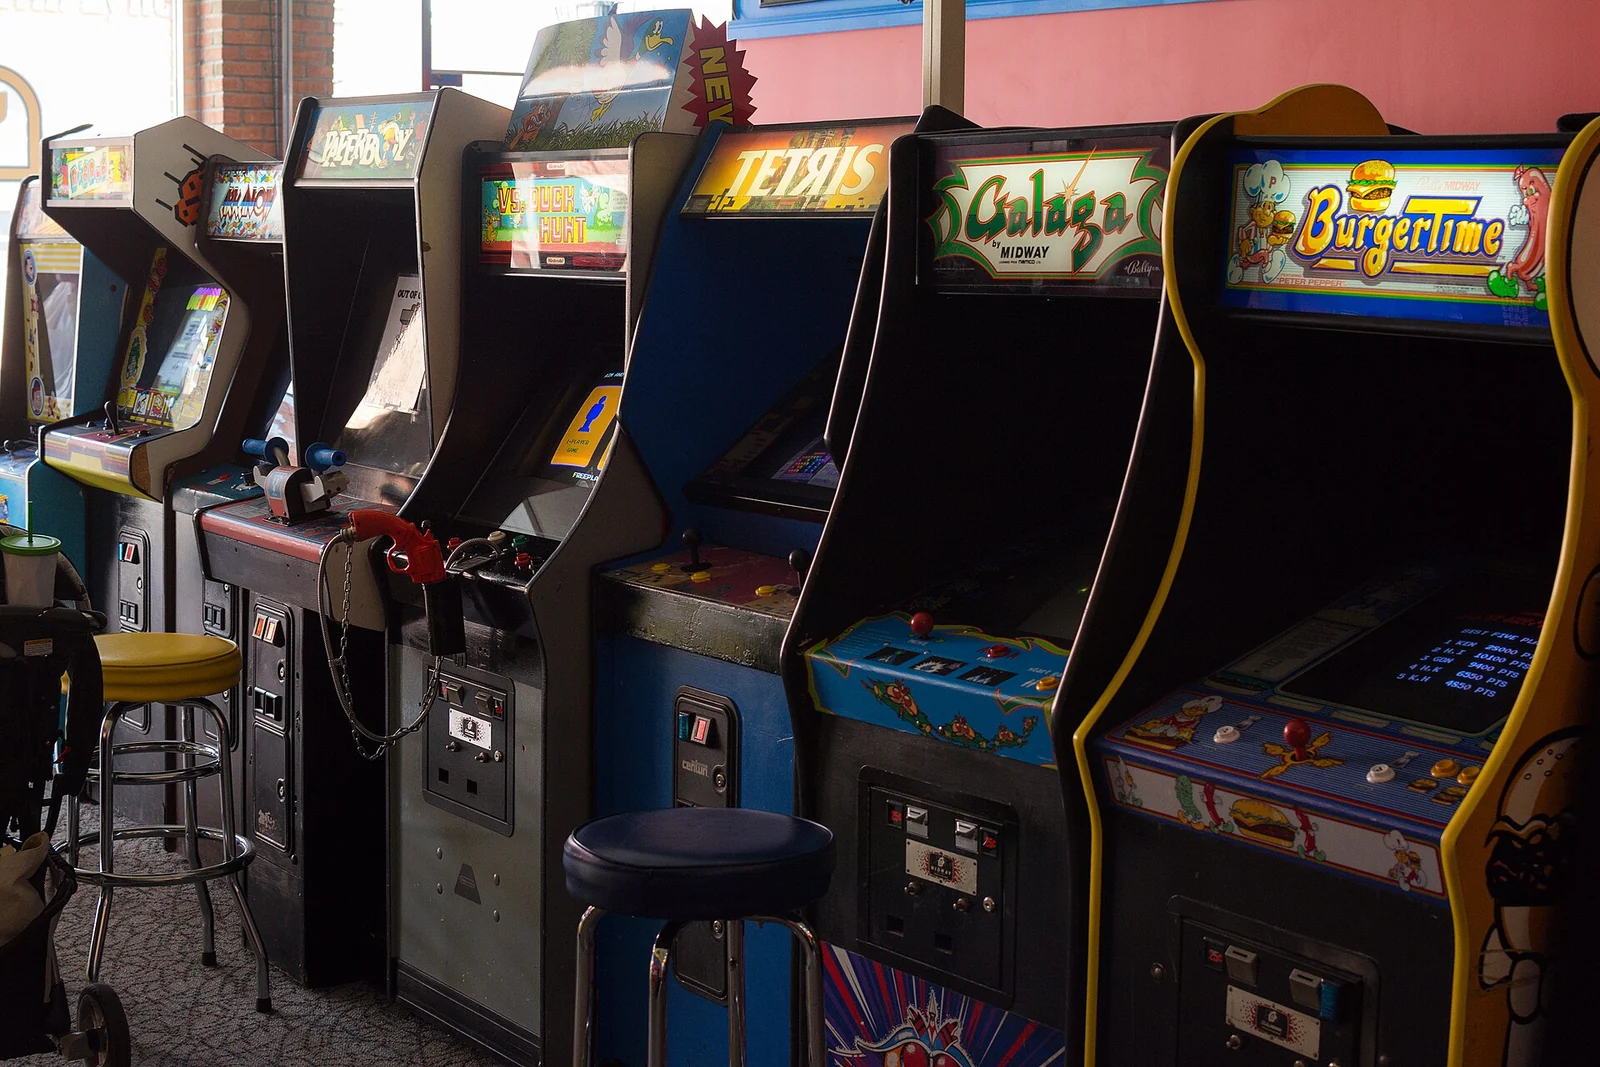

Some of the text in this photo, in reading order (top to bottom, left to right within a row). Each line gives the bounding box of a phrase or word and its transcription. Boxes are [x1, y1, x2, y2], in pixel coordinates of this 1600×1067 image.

[725, 144, 884, 197] TETRIS
[528, 186, 575, 213] DUCK
[965, 168, 1133, 277] Galaga
[539, 216, 586, 243] HUNT
[992, 239, 1001, 249] by
[1000, 246, 1050, 259] MIDWAY
[1127, 260, 1152, 277] Bally
[398, 290, 410, 298] OUT
[410, 291, 418, 299] OF
[572, 472, 599, 482] FREEPLA
[1461, 628, 1490, 636] BEST
[1490, 631, 1519, 641] FIVE
[1473, 652, 1507, 663] 10100
[1508, 660, 1531, 670] PTS
[1520, 651, 1535, 660] PT
[1497, 668, 1520, 679] PTS
[1486, 677, 1508, 688] PTS
[1474, 687, 1497, 698] PTS
